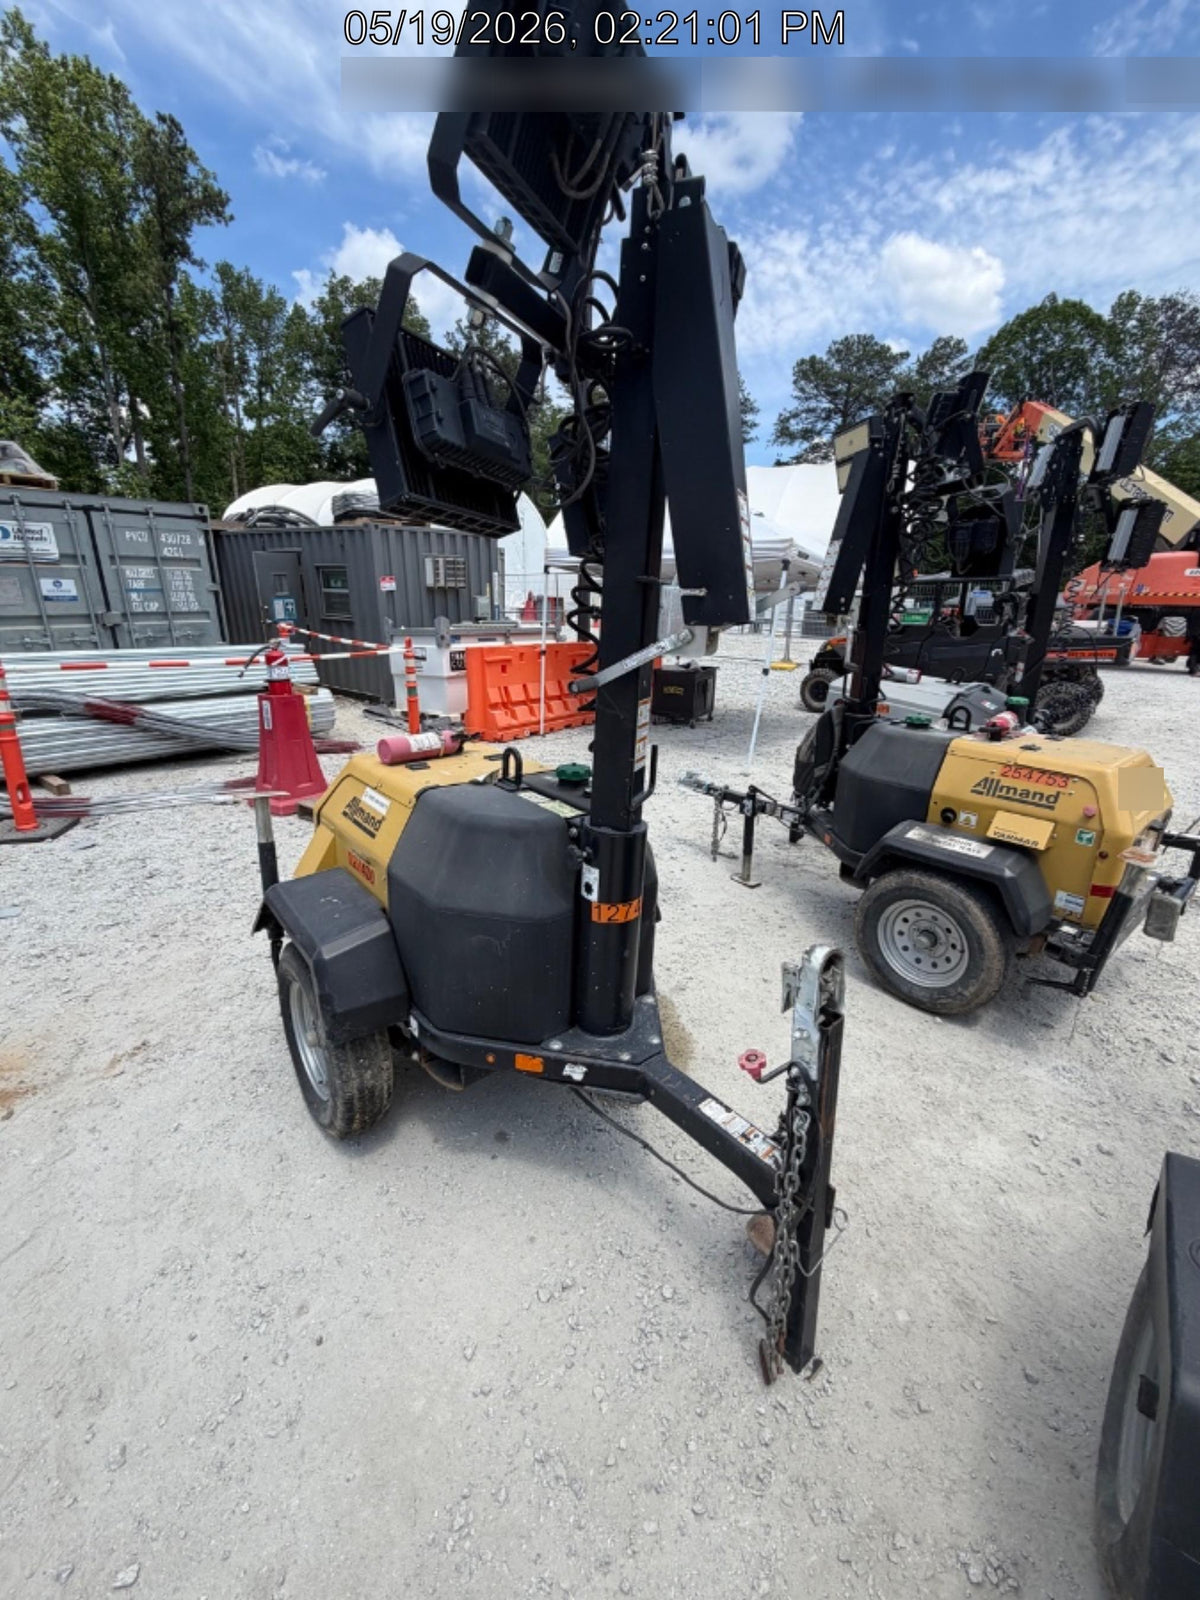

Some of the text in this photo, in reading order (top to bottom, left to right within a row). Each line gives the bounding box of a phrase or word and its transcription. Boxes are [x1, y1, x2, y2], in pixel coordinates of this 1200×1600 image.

[971, 777, 1061, 808] Allmand
[344, 796, 386, 834] Allmand
[993, 830, 1040, 847] YANMAR
